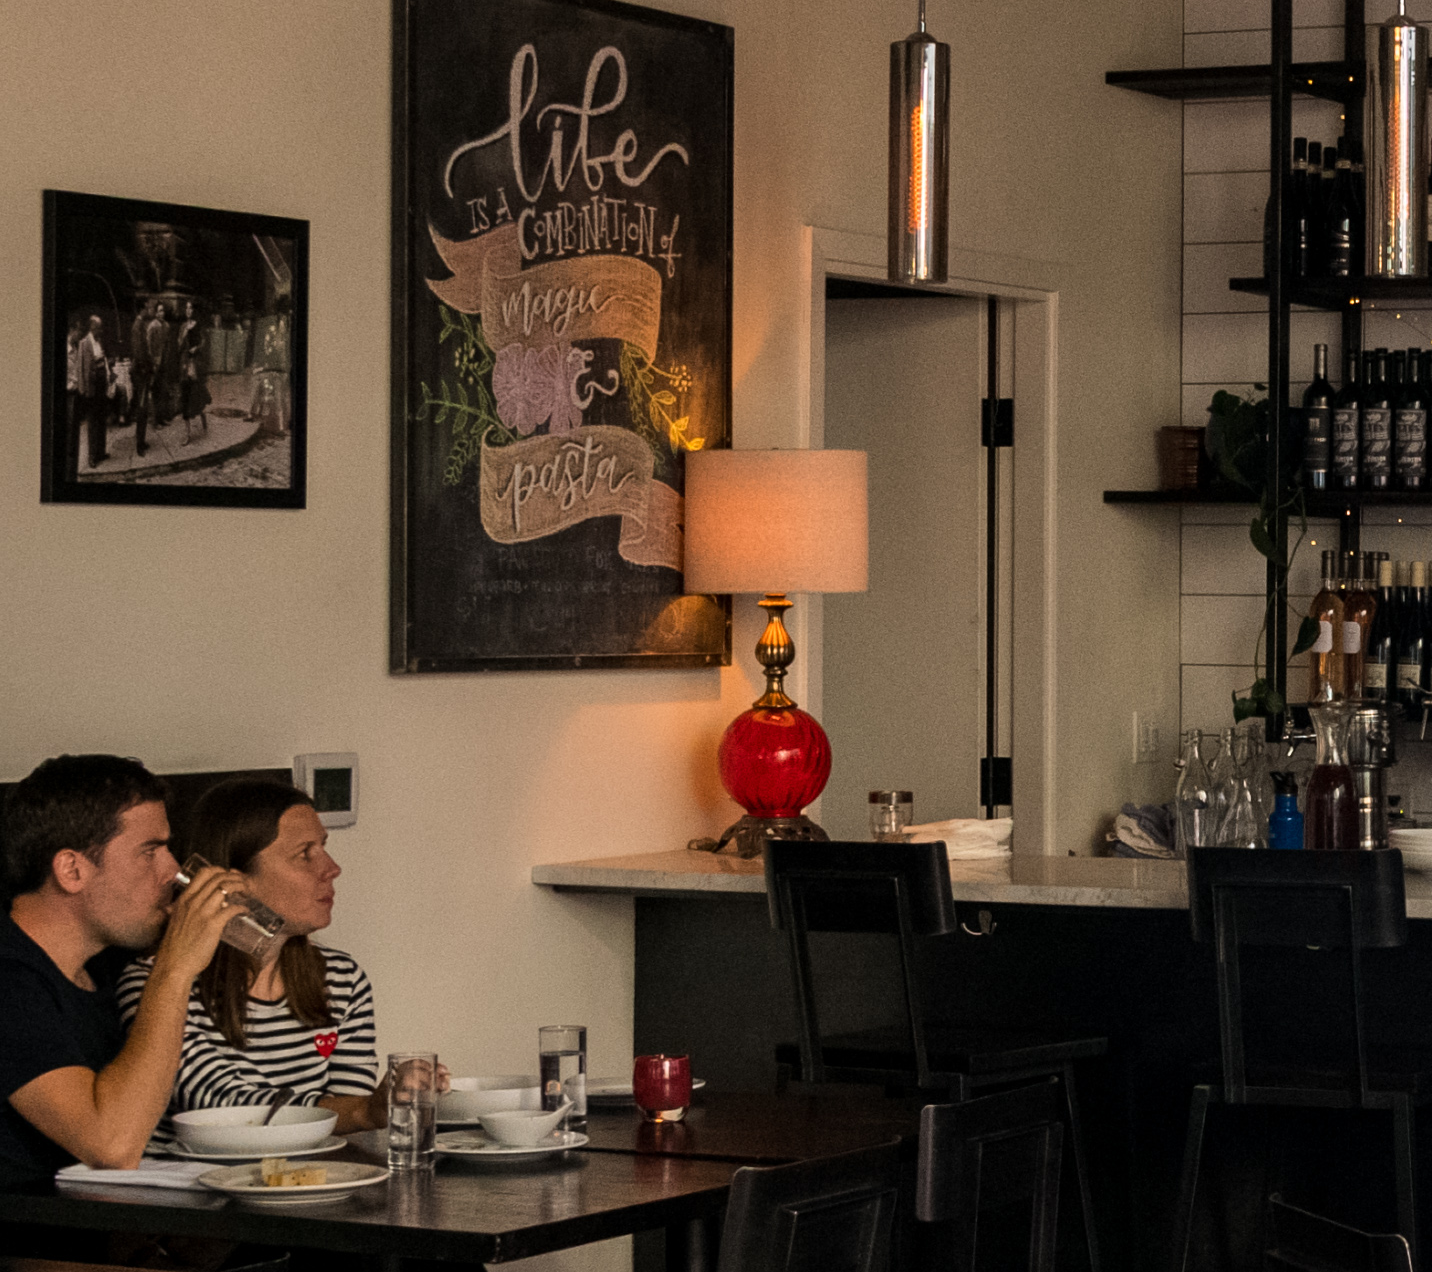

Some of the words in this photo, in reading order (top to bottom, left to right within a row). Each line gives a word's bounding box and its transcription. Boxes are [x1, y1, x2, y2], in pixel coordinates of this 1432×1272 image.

[466, 196, 490, 234] IS
[495, 187, 514, 225] A
[658, 214, 682, 278] of
[496, 435, 635, 534] pasta
